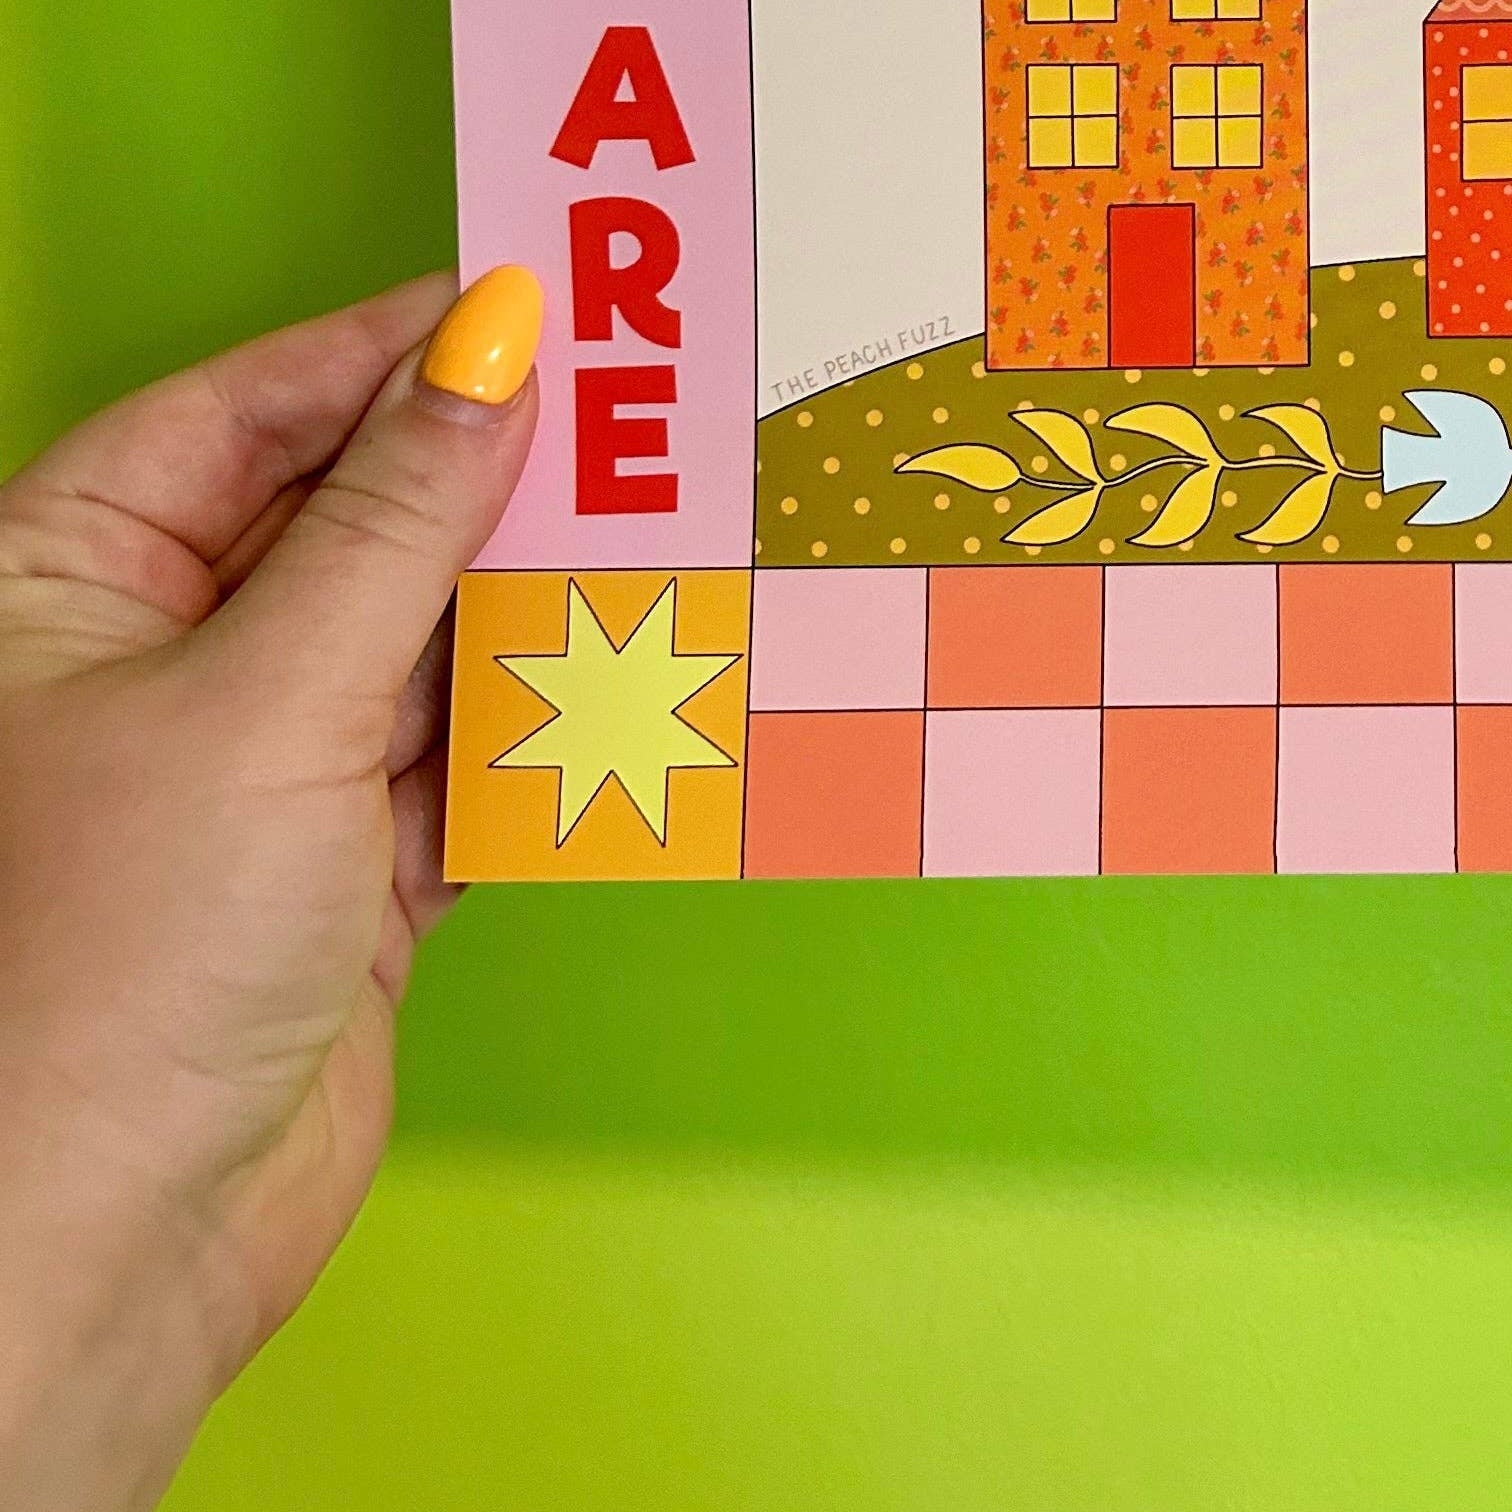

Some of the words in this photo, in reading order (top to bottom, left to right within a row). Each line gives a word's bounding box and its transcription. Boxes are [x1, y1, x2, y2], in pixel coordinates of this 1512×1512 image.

[548, 25, 697, 517] ARE
[771, 368, 818, 402] THE
[824, 338, 892, 380] PEACH
[899, 316, 955, 350] FUZZ
